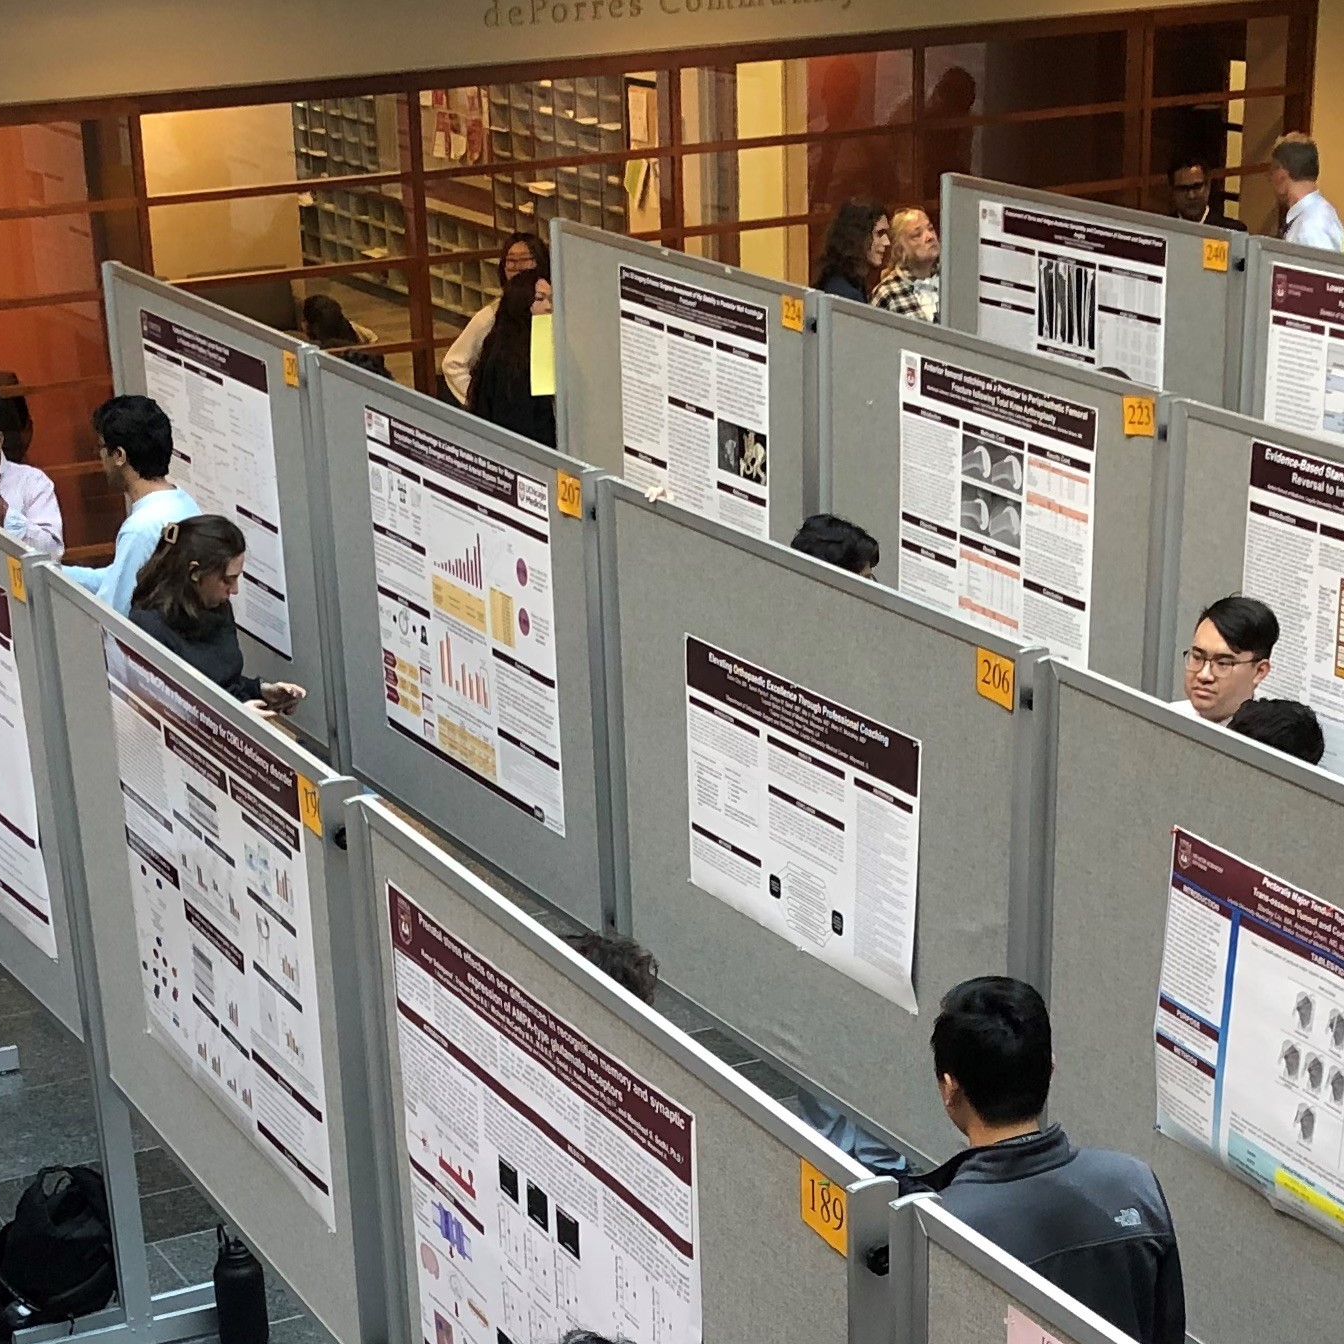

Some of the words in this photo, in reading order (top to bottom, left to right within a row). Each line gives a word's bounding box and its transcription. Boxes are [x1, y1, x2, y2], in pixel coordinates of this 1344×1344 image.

[1206, 244, 1226, 263] 240
[1326, 283, 1343, 293] Lower
[784, 302, 801, 321] 224
[1129, 404, 1151, 425] 223
[1265, 448, 1323, 476] Evidence-Based
[561, 481, 580, 508] 207
[1291, 472, 1323, 492] Reversal
[1325, 483, 1334, 495] to
[981, 659, 1010, 694] 206
[708, 651, 732, 674] Elevating
[733, 664, 765, 688] Orthopaedic
[766, 679, 797, 702] Excellence
[798, 693, 821, 714] Through
[823, 705, 858, 731] Professional
[859, 723, 889, 747] Coaching
[1262, 876, 1290, 898] Pectoralis
[1291, 891, 1309, 906] Major
[1253, 887, 1295, 915] Trans-osseous
[1296, 909, 1317, 925] Tunnel
[1318, 921, 1330, 932] and
[418, 912, 442, 942] Prenatal
[486, 970, 495, 983] on
[496, 977, 508, 994] sex
[509, 987, 547, 1024] differences
[548, 1015, 555, 1031] in
[557, 1025, 598, 1064] recognition
[599, 1058, 631, 1092] memory
[633, 1083, 648, 1102] and
[650, 1096, 684, 1130] synaptic
[467, 972, 502, 1007] expression
[503, 1001, 510, 1014] of
[512, 1006, 548, 1044] AMPA-type
[551, 1038, 585, 1073] glutamate
[587, 1067, 622, 1102] receptors
[809, 1179, 845, 1231] 189
